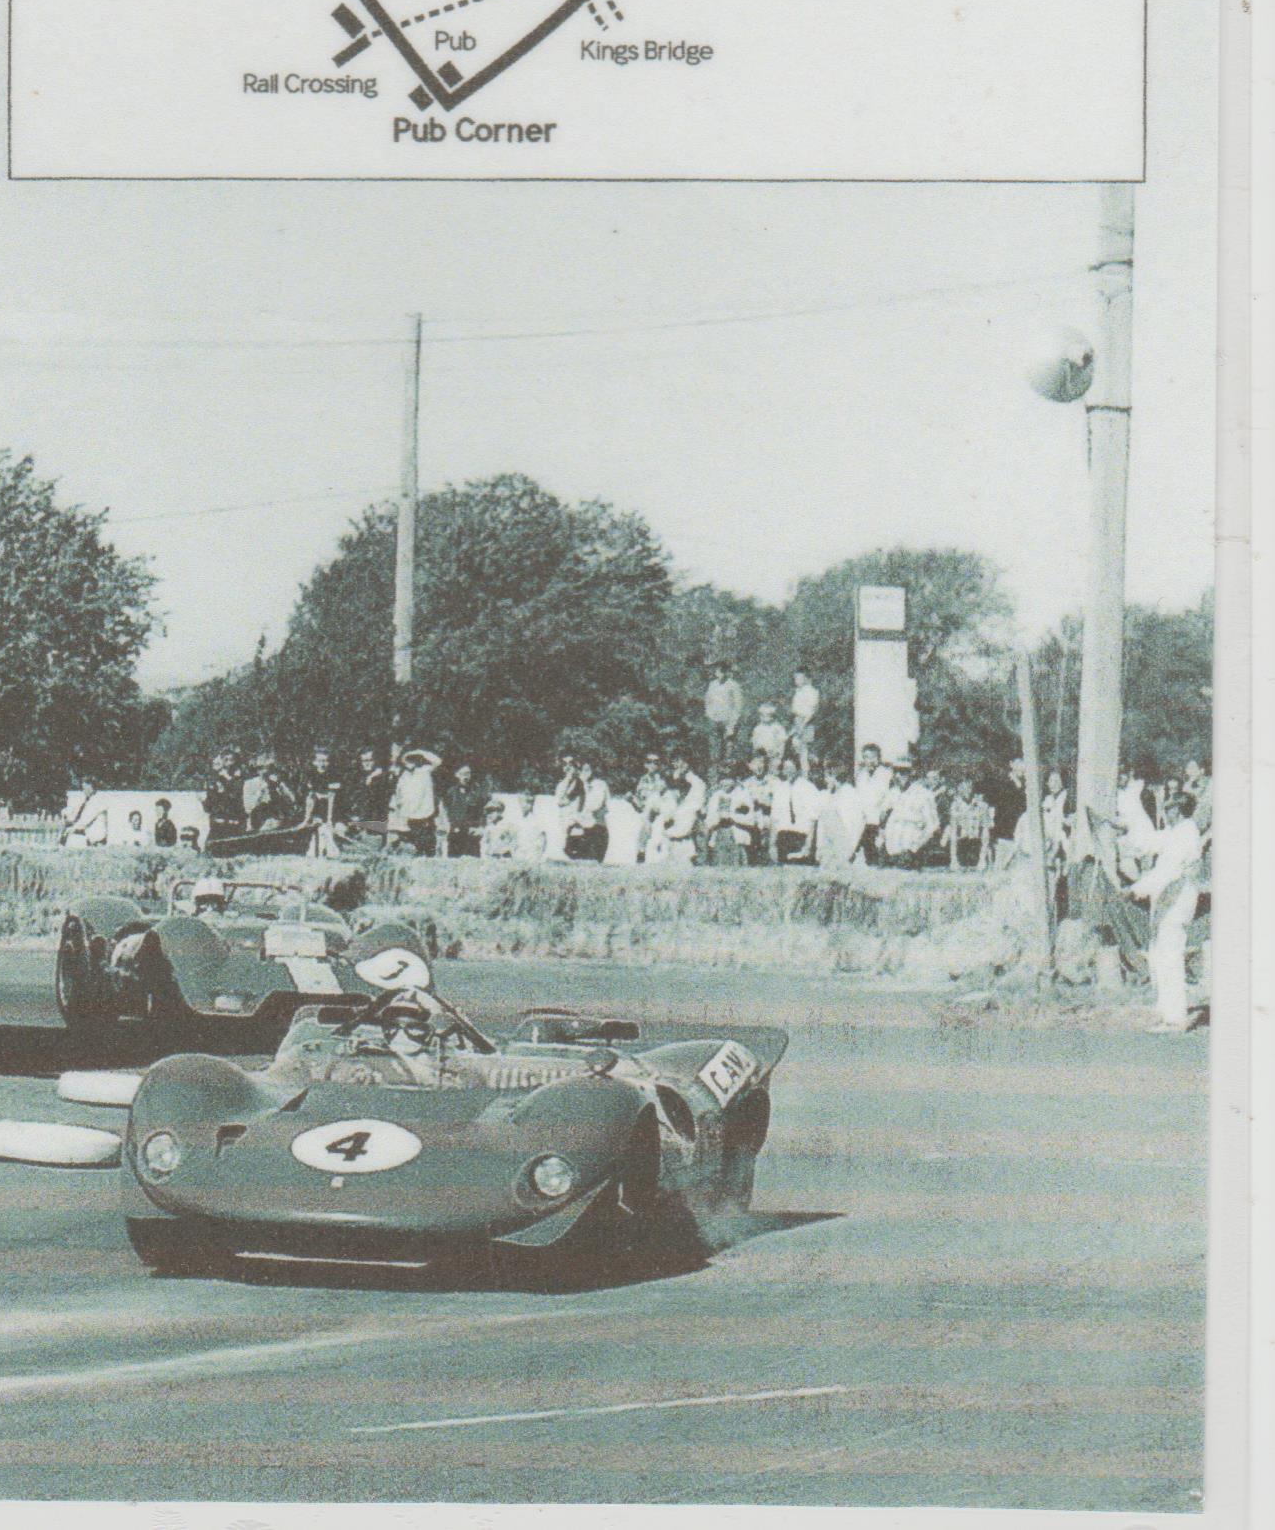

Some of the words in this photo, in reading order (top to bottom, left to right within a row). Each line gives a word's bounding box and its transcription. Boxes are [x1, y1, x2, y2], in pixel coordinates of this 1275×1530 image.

[435, 31, 476, 51] Pub
[581, 41, 639, 65] Kings
[645, 41, 713, 65] Bridge
[244, 73, 278, 93] Rail
[285, 74, 378, 98] Crossing
[394, 117, 446, 142] Pub
[455, 117, 557, 143] Corner
[326, 1131, 371, 1161] 4
